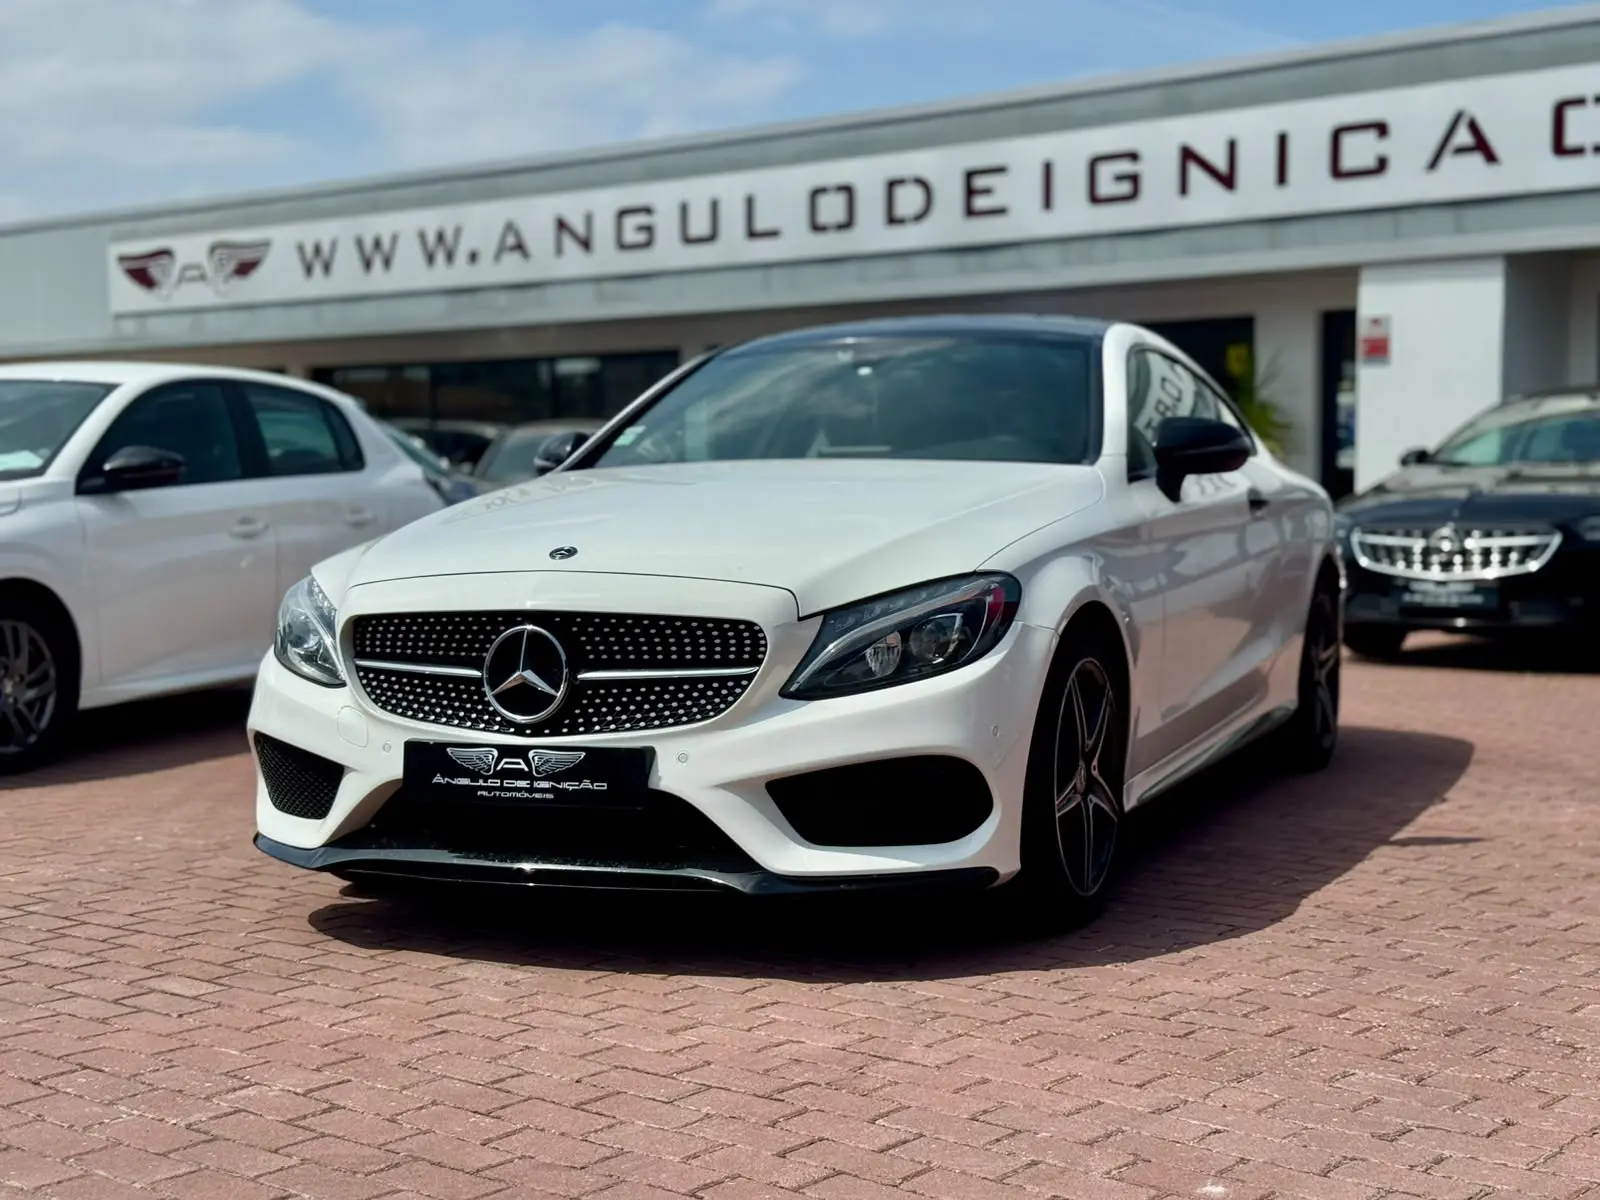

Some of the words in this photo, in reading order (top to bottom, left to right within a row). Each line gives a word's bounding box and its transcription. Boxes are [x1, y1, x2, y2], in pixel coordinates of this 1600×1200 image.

[496, 758, 529, 772] A
[432, 773, 500, 786] ÂNGULO
[503, 780, 531, 788] DE
[533, 779, 607, 791] IGNIÇÃO
[477, 790, 554, 799] AUTOMÓVEIS
